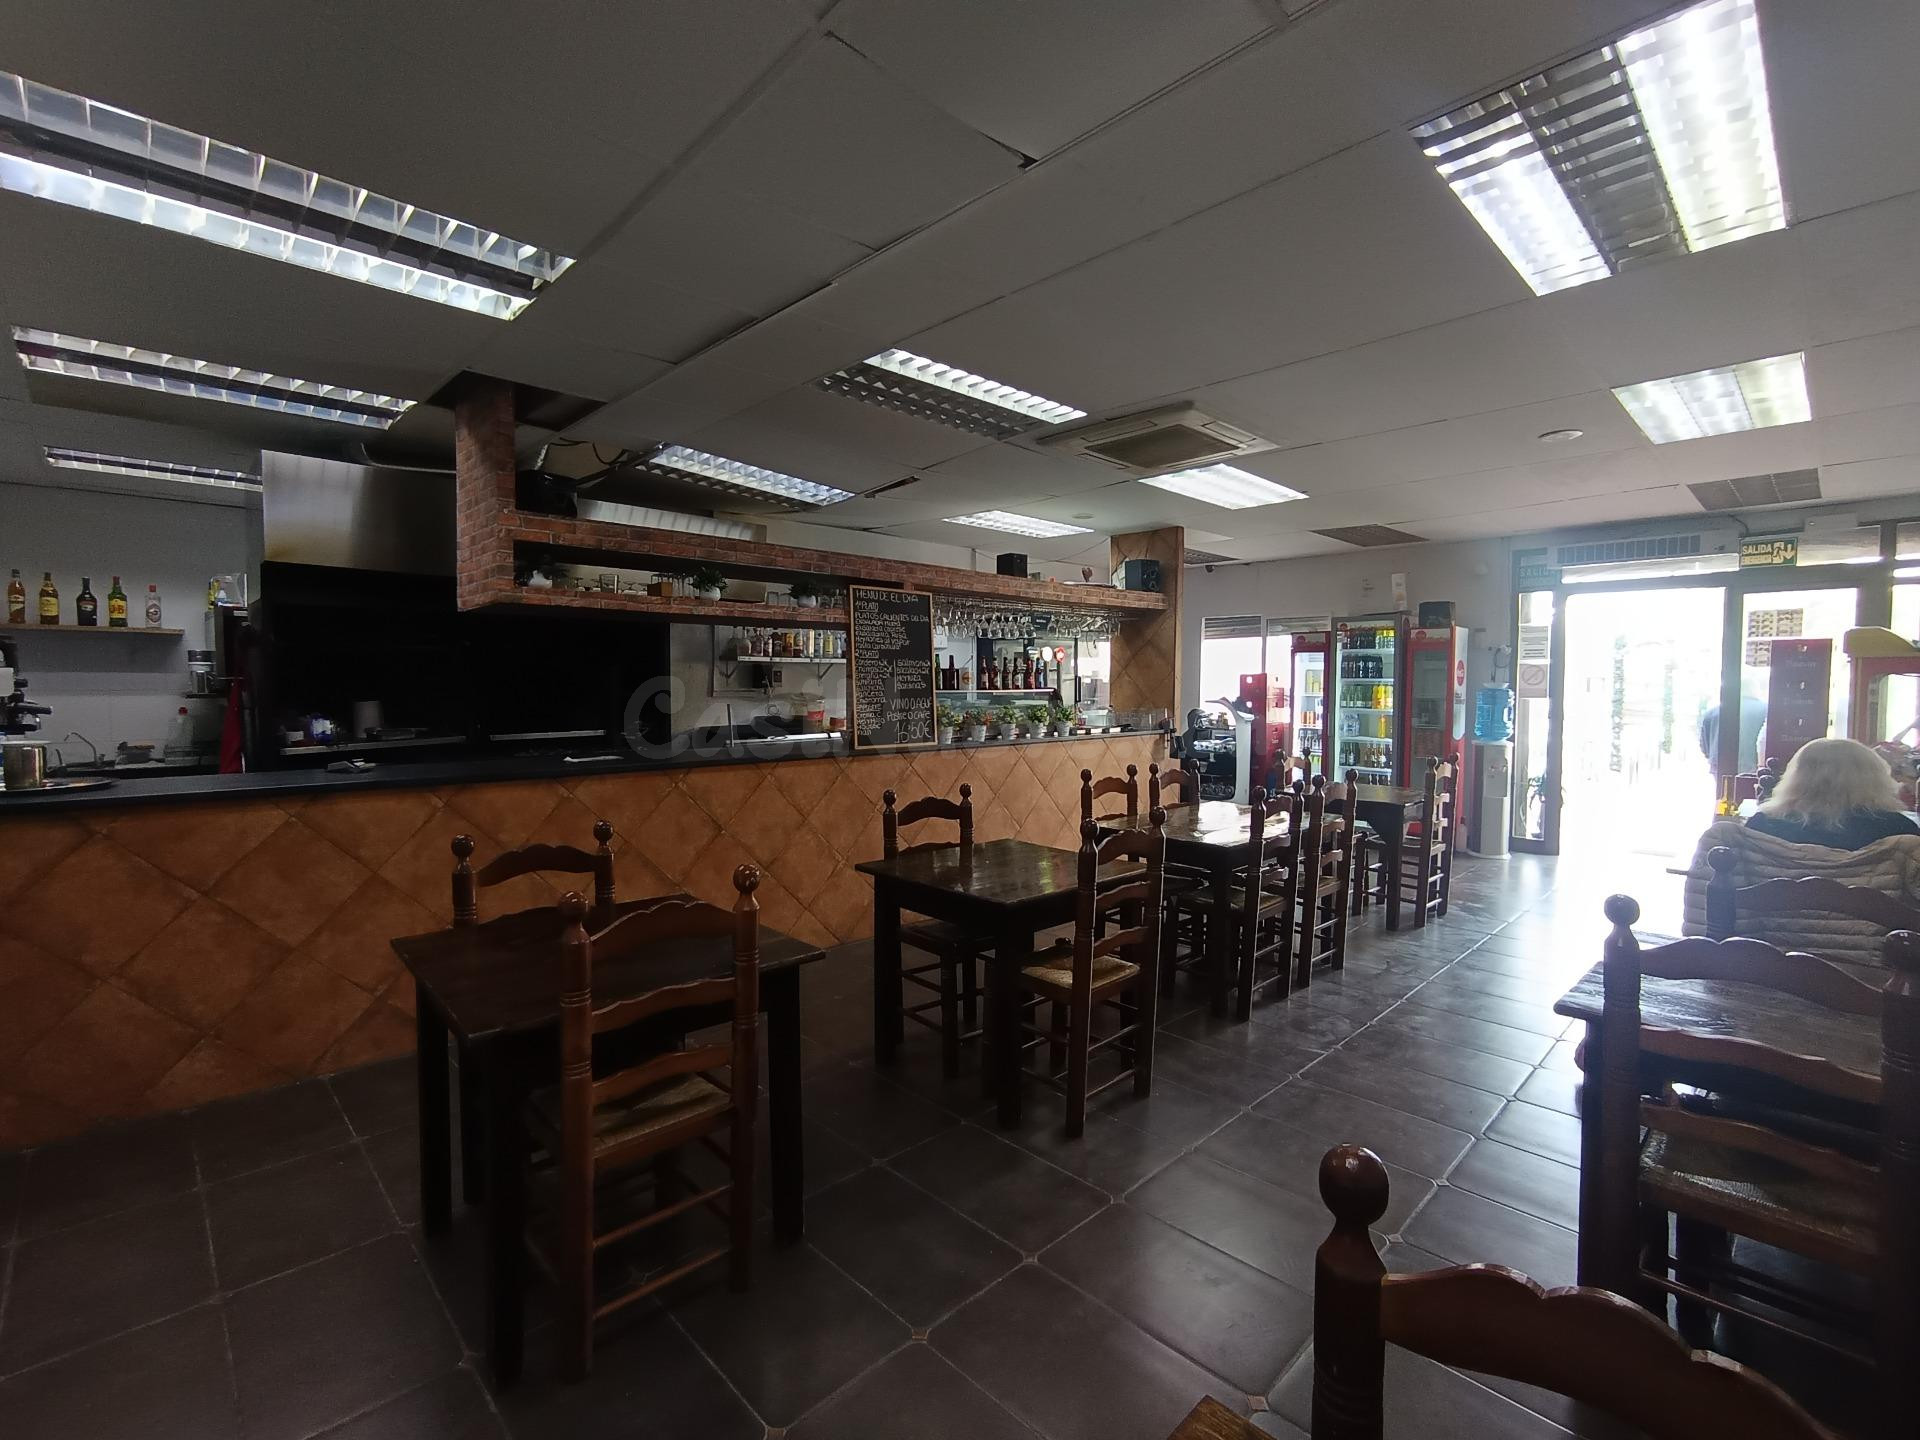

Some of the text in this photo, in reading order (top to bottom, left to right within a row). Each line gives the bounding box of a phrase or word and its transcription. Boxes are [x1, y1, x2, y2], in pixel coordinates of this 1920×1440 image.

[1743, 544, 1771, 554] SALIDA
[856, 590, 878, 600] MENU
[879, 591, 889, 601] DE
[890, 593, 901, 603] EL
[890, 698, 909, 710] VINO
